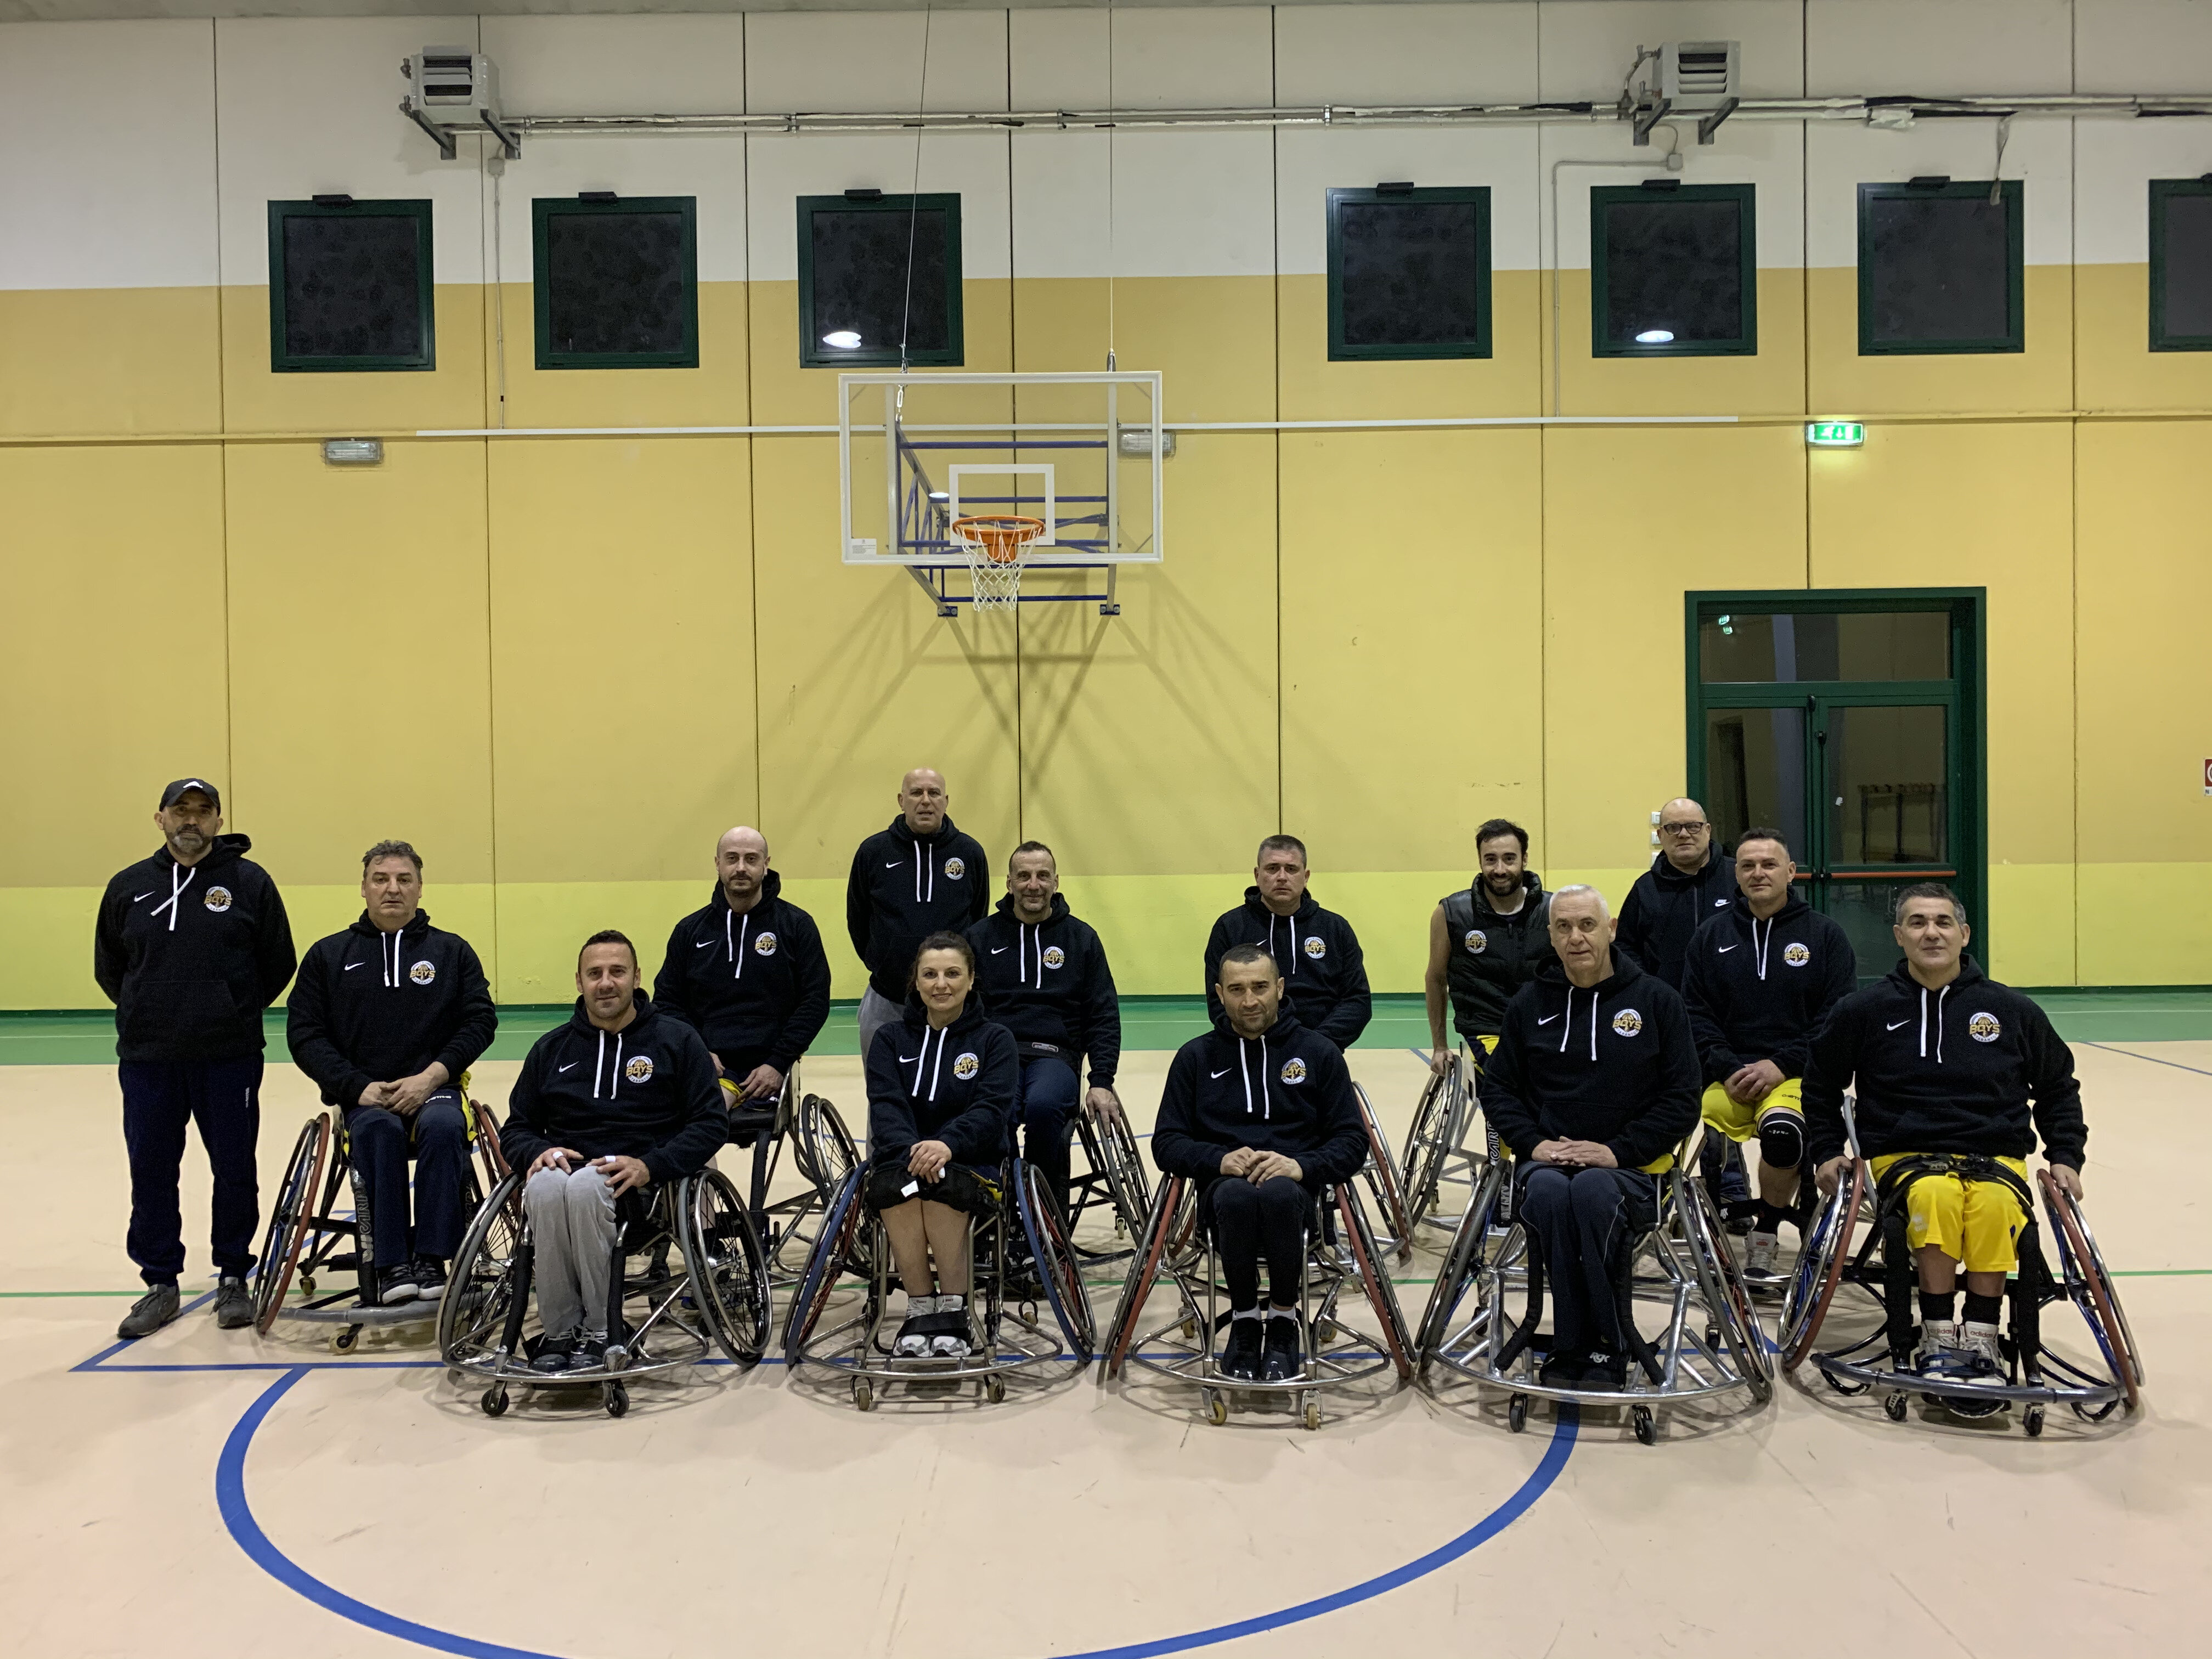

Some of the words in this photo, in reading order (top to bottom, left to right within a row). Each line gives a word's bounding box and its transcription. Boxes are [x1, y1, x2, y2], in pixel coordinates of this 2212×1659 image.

[204, 895, 232, 905] BOYS
[755, 940, 777, 950] BOYS
[1784, 952, 1809, 961] BOYS
[1612, 1019, 1642, 1030] BOYS
[1970, 1024, 2000, 1035] BOYS
[626, 1065, 653, 1077] BOYS
[953, 1060, 979, 1074] BOYS
[1281, 1068, 1306, 1079] BOYS
